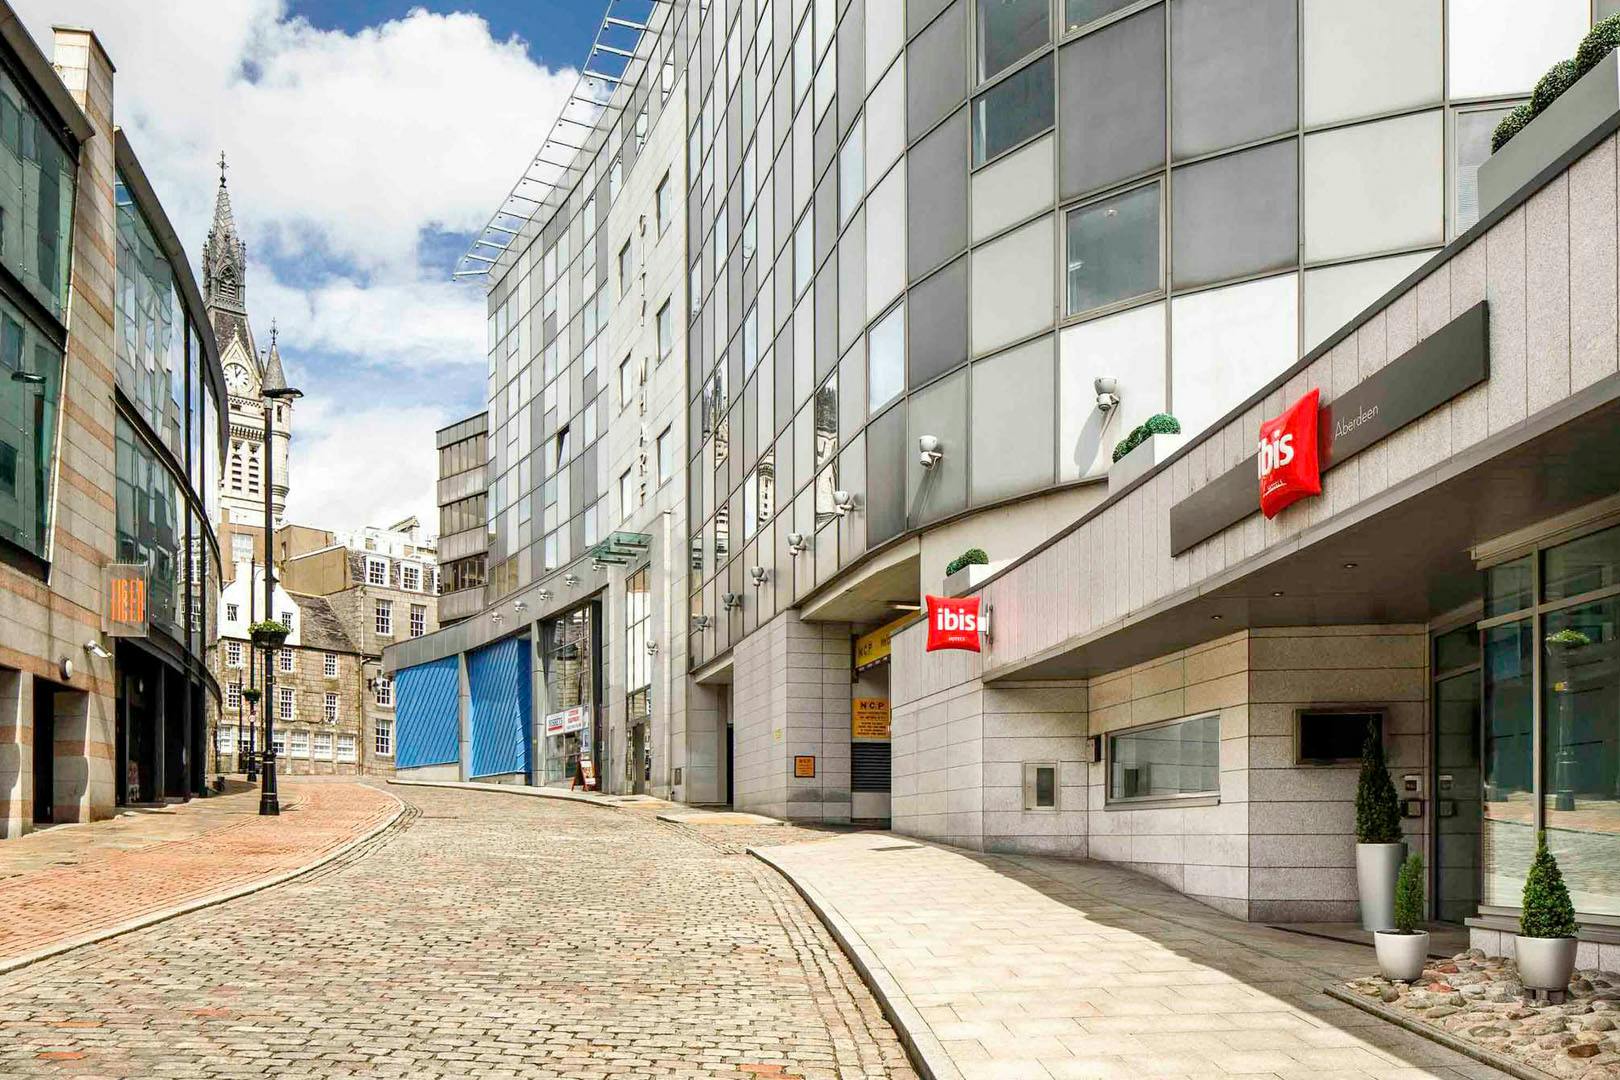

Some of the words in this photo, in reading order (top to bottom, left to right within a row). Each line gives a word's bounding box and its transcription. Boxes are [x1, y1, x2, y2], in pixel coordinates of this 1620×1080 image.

[1334, 403, 1380, 440] Aberdeen
[1257, 429, 1294, 480] ibis
[937, 607, 976, 631] ibis
